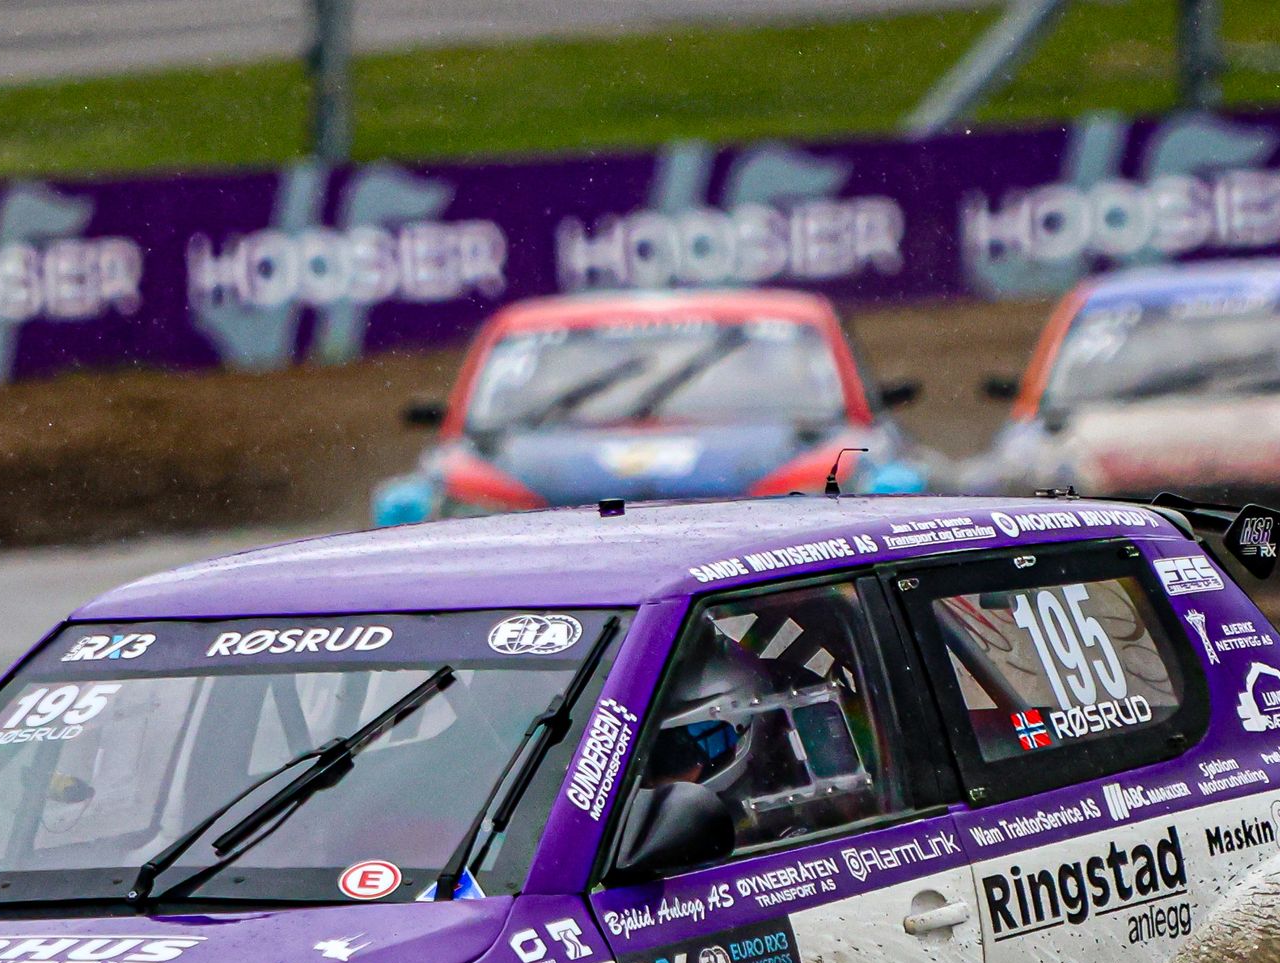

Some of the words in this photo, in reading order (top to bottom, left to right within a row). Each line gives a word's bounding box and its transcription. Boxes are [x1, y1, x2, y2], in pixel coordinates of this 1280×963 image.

[558, 197, 904, 292] HOOSIER
[186, 219, 508, 310] HOOSIER
[882, 531, 939, 547] Transport
[937, 530, 955, 542] og
[952, 525, 996, 539] Graving
[1015, 511, 1081, 532] MORTEN
[1078, 511, 1146, 526] BRUVOLD
[1240, 517, 1274, 545] MSR
[689, 557, 750, 583] SANDE
[744, 538, 855, 572] MULTISERVICE
[852, 534, 879, 554] AS
[1261, 543, 1277, 557] RX
[207, 626, 394, 657] RØSRUD
[493, 622, 570, 647] FIA
[1215, 636, 1262, 651] NETTBYGG
[1261, 634, 1273, 646] AS
[1222, 622, 1256, 636] BJERKE
[68, 634, 156, 661] RX3
[1013, 583, 1128, 711] 195
[2, 684, 122, 729] 195
[1050, 695, 1152, 740] RØSRUD
[567, 706, 622, 811] GUNDERSEN
[589, 723, 632, 821] MOTORSPORT
[1198, 758, 1239, 779] Sjøblom
[1122, 785, 1150, 810] ABC
[1198, 769, 1269, 796] Motorutvikling
[970, 826, 1004, 847] Wam
[999, 805, 1085, 840] TraktorService
[1082, 798, 1101, 820] AS
[1204, 816, 1274, 857] Maskin
[862, 831, 961, 874] AlarmLink
[358, 870, 384, 889] E
[736, 857, 840, 897] ØYNEBRÅTEN
[755, 882, 818, 908] TRANSPORT
[821, 878, 837, 893] AS
[982, 826, 1187, 934] Ringstad
[658, 897, 705, 923] Anlegg
[708, 884, 734, 911] AS
[1127, 900, 1192, 944] anlegg
[730, 938, 765, 960] EURO
[766, 931, 789, 953] RX3
